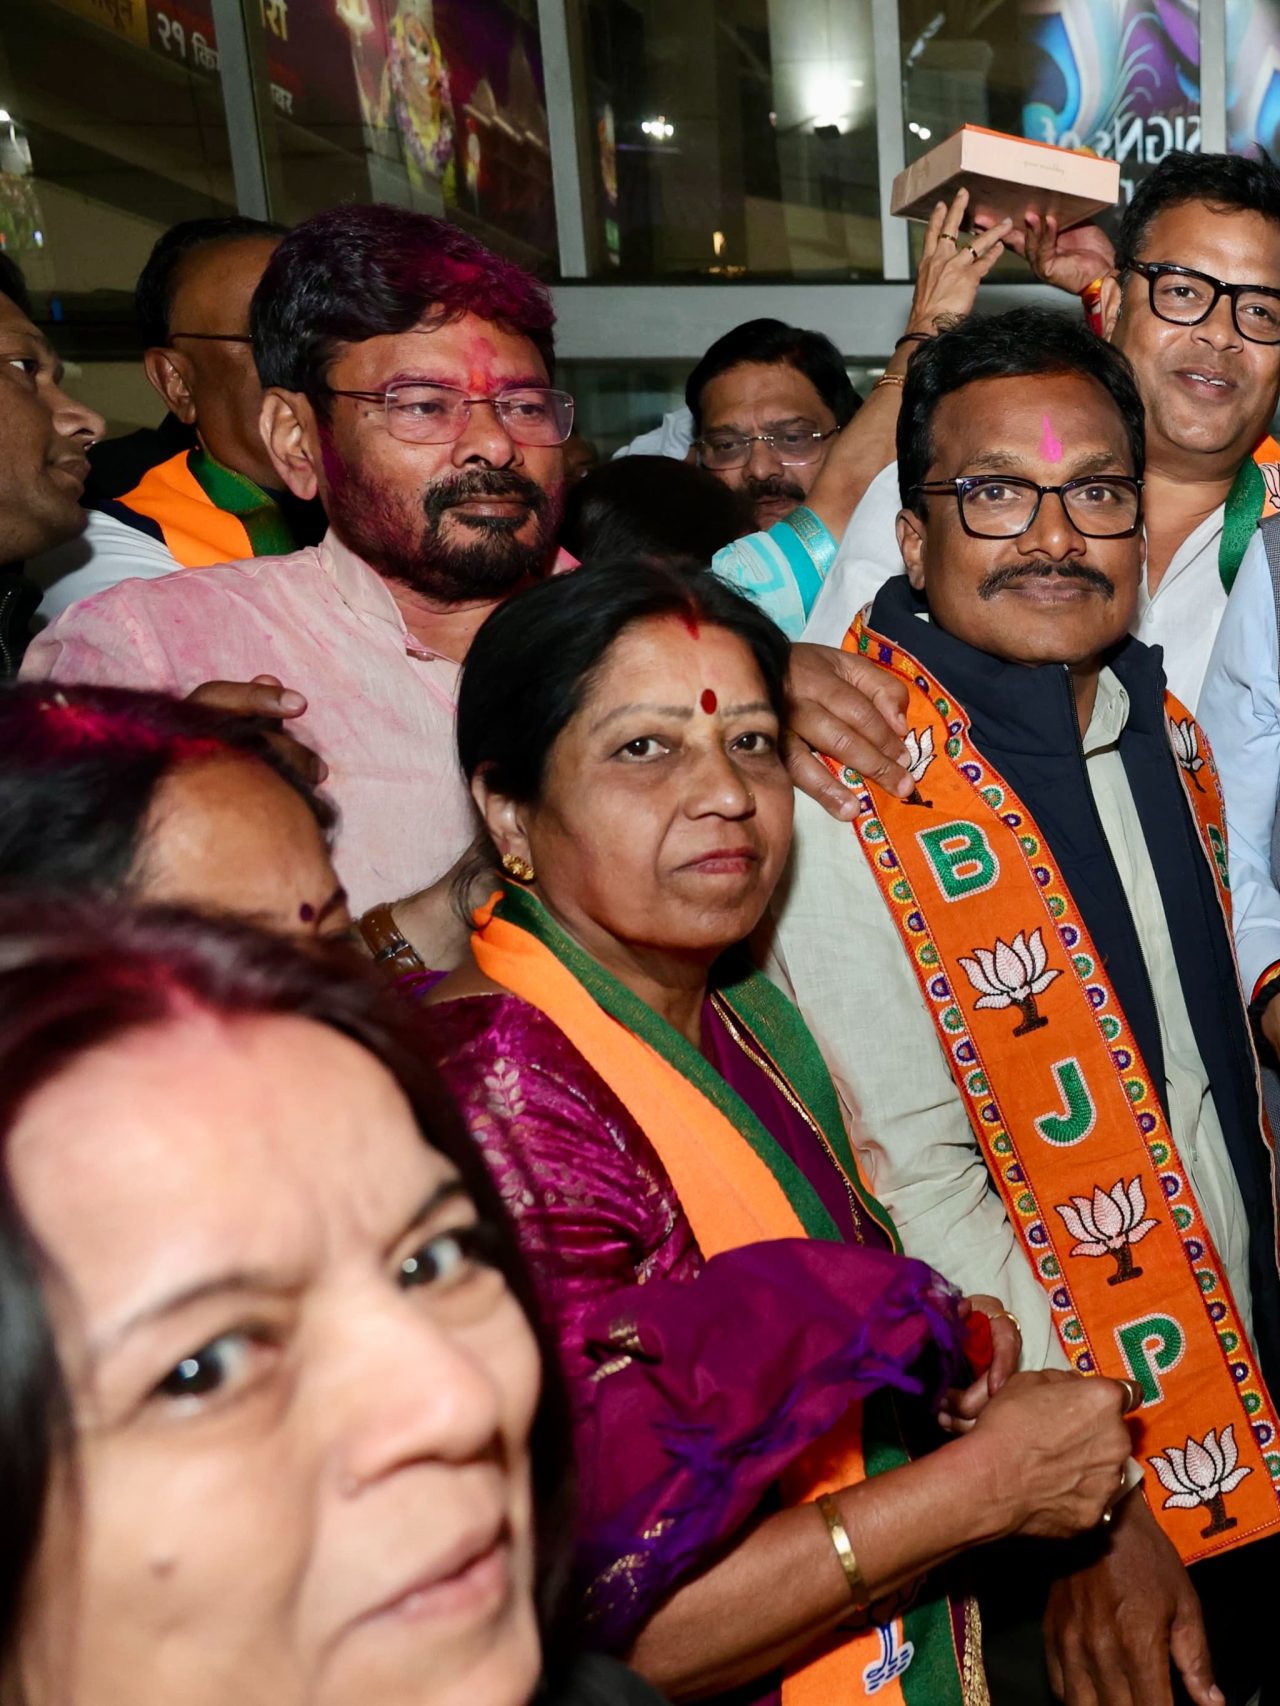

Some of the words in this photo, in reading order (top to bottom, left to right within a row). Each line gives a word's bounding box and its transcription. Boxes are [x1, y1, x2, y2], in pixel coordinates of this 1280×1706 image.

[914, 819, 1002, 903] B
[1033, 1055, 1098, 1147] J
[1113, 1312, 1187, 1409] P
